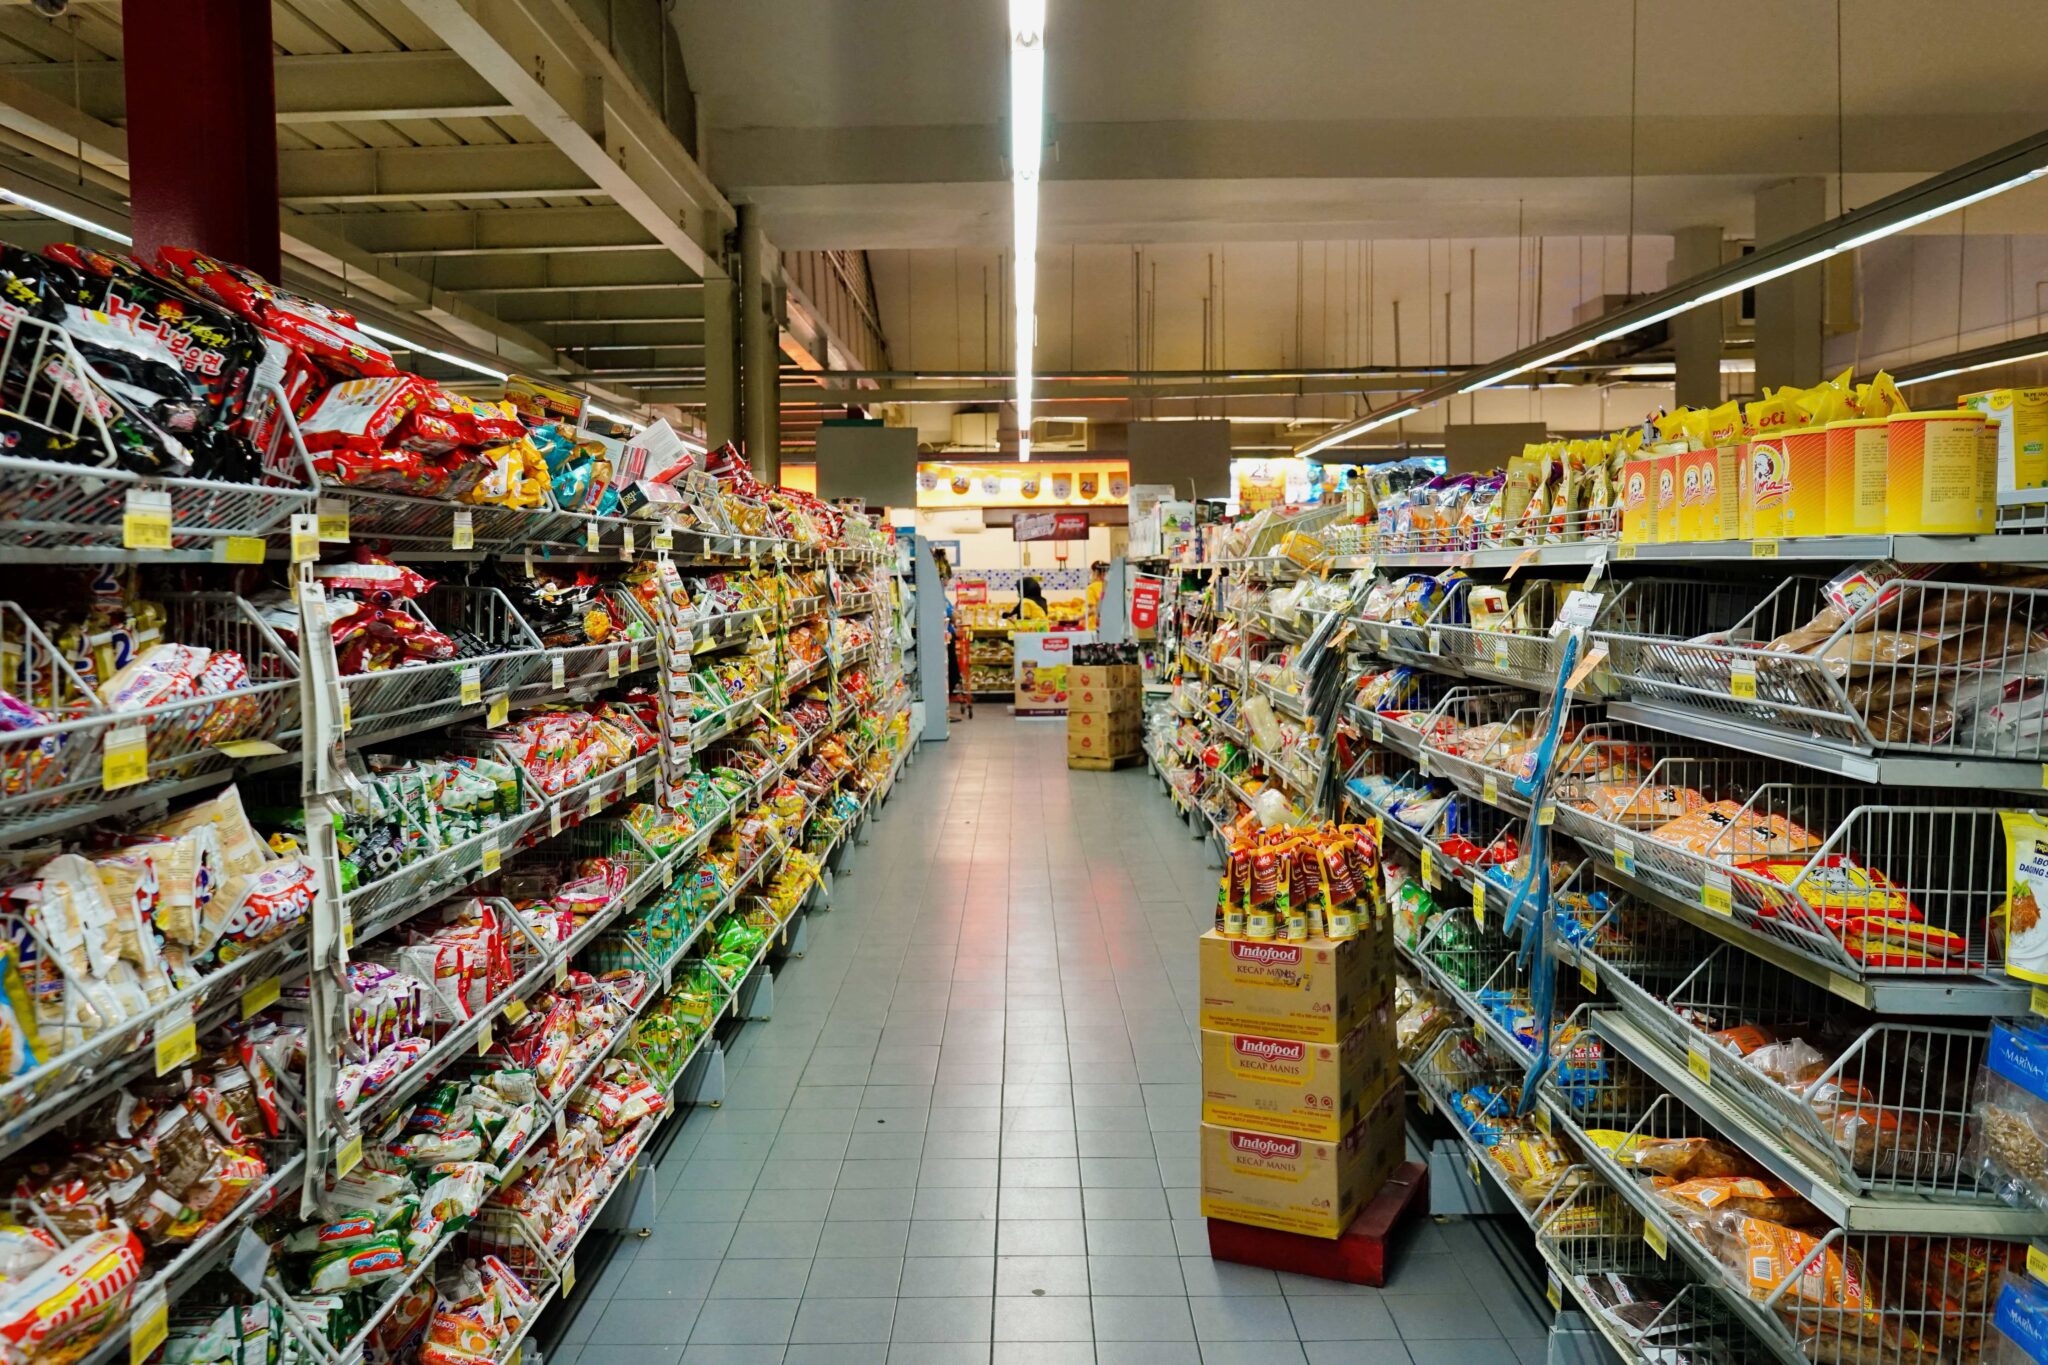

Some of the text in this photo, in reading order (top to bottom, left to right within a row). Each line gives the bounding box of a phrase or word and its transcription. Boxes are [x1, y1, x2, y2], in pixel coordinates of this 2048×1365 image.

[1759, 411, 1786, 428] oli
[1712, 423, 1734, 439] moli
[1238, 944, 1297, 963] Indofood
[1237, 965, 1264, 975] KECAP
[1242, 1040, 1300, 1058] Indofood
[1240, 1060, 1299, 1075] KECAP MANIS
[1238, 1136, 1296, 1155] Indofood
[1236, 1156, 1296, 1172] KECAP MANIS
